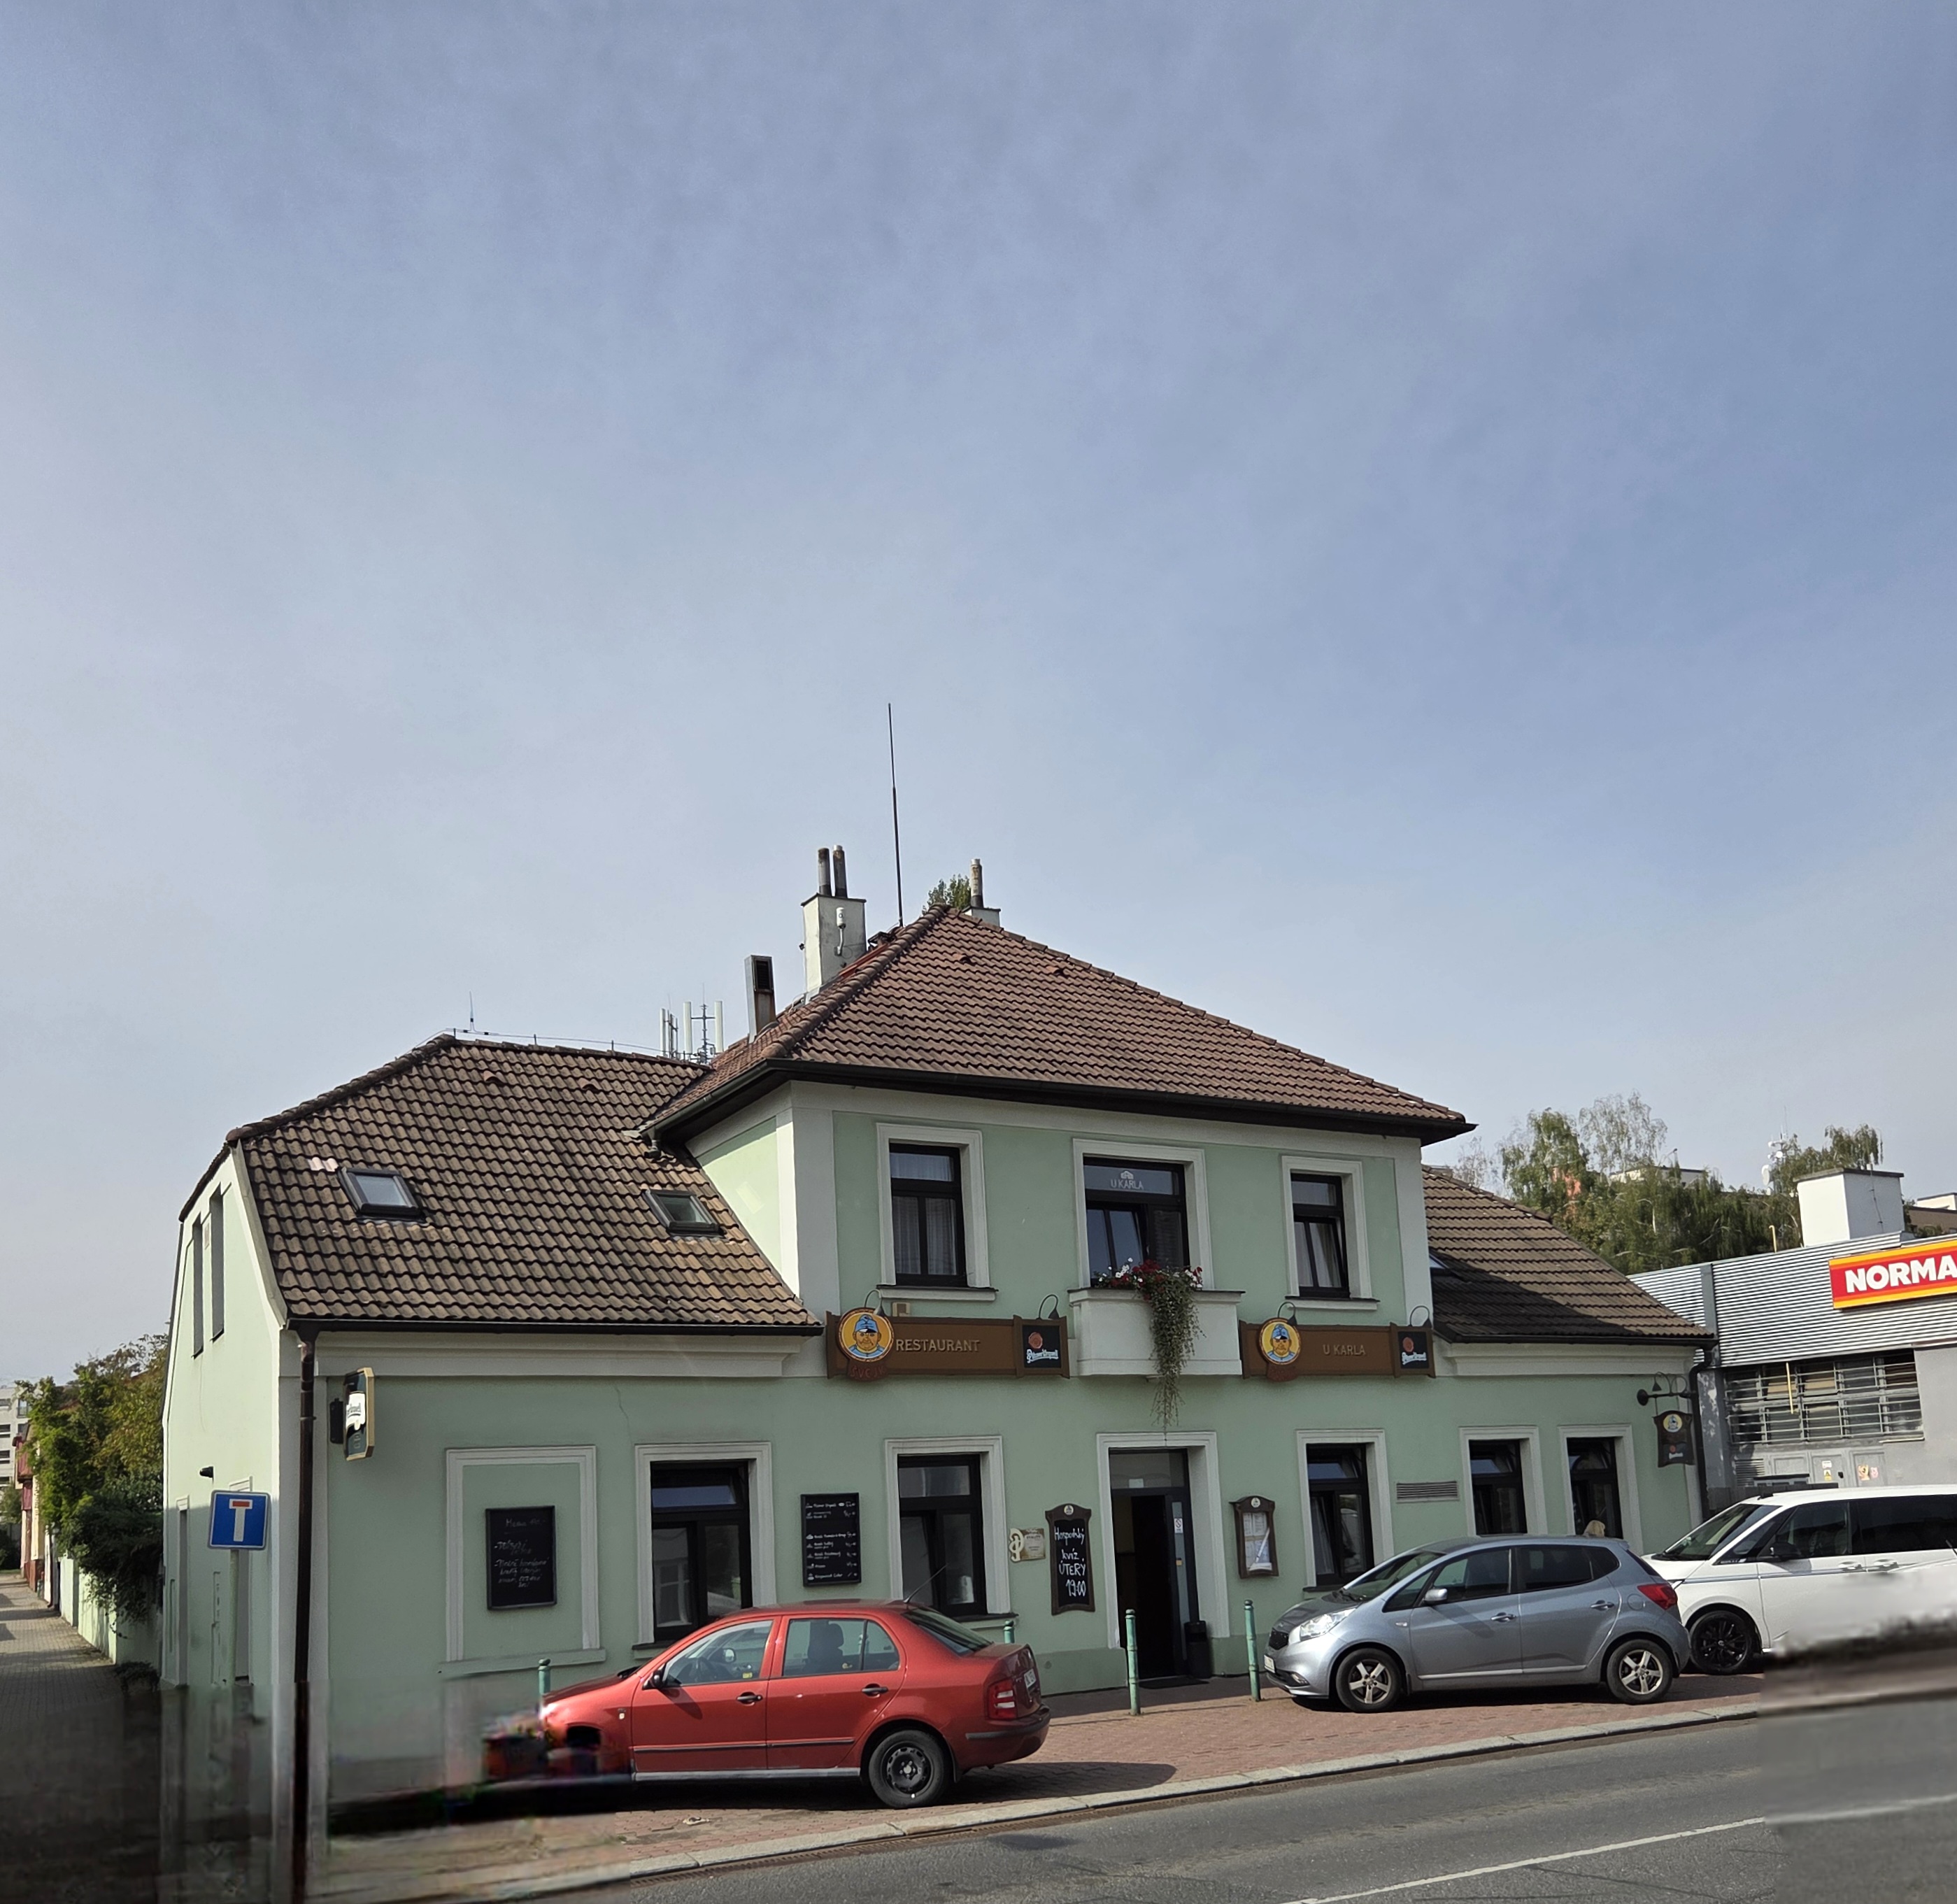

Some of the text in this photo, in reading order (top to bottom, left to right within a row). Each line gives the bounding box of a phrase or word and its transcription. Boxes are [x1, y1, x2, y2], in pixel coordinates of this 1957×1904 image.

[1111, 1179, 1144, 1190] U KARLA
[1844, 1254, 1957, 1293] NORMA
[895, 1338, 981, 1352] RESTAURANT
[1323, 1344, 1366, 1356] U KARLA
[1058, 1558, 1086, 1576] ÚTERÝ
